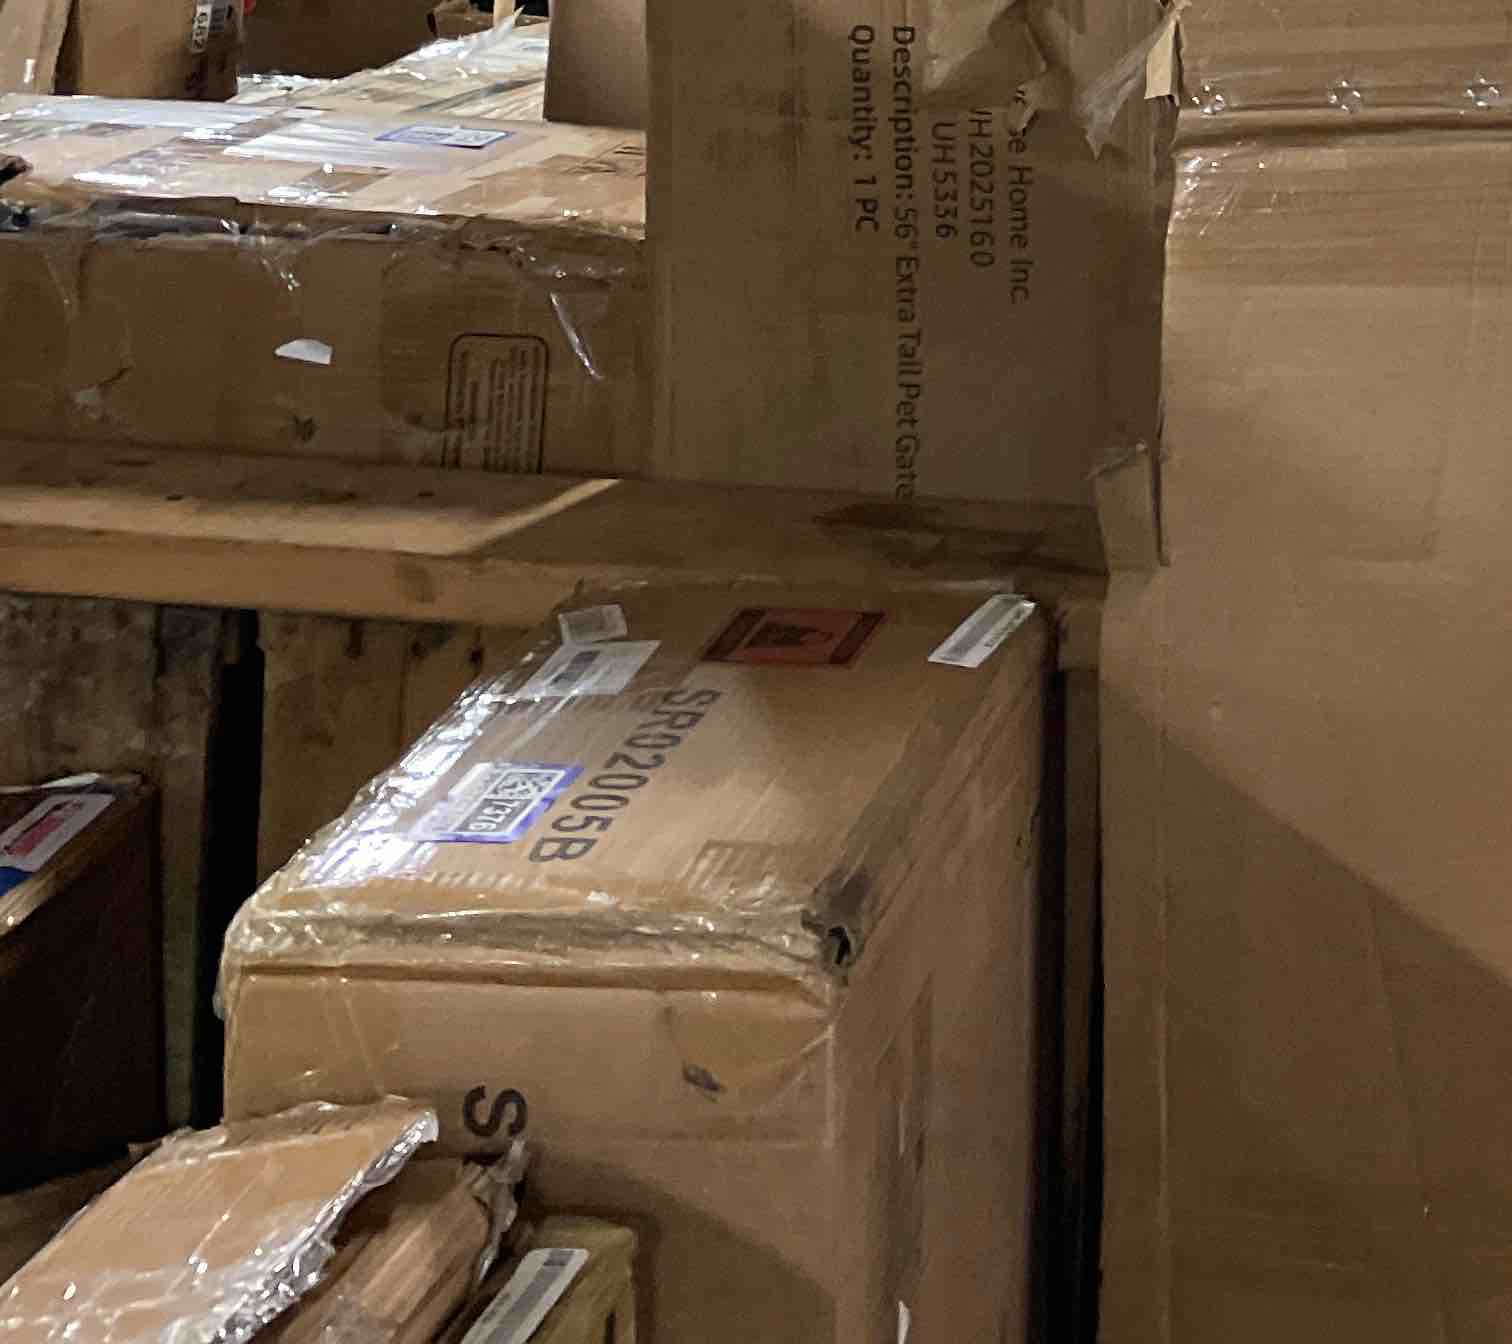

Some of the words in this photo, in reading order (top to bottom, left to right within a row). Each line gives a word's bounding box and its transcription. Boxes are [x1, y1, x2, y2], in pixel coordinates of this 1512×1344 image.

[848, 24, 878, 161] Quantity:
[888, 26, 918, 199] Description:
[931, 122, 959, 240] UH5336
[1008, 166, 1034, 249] Home
[855, 198, 880, 232] PC
[896, 257, 919, 322] Extra
[1010, 258, 1035, 304] Inc
[898, 328, 922, 376] Tall
[897, 383, 921, 428] Pet
[896, 435, 919, 499] Gate
[530, 688, 721, 863] SR02005B
[463, 1085, 528, 1137] S
